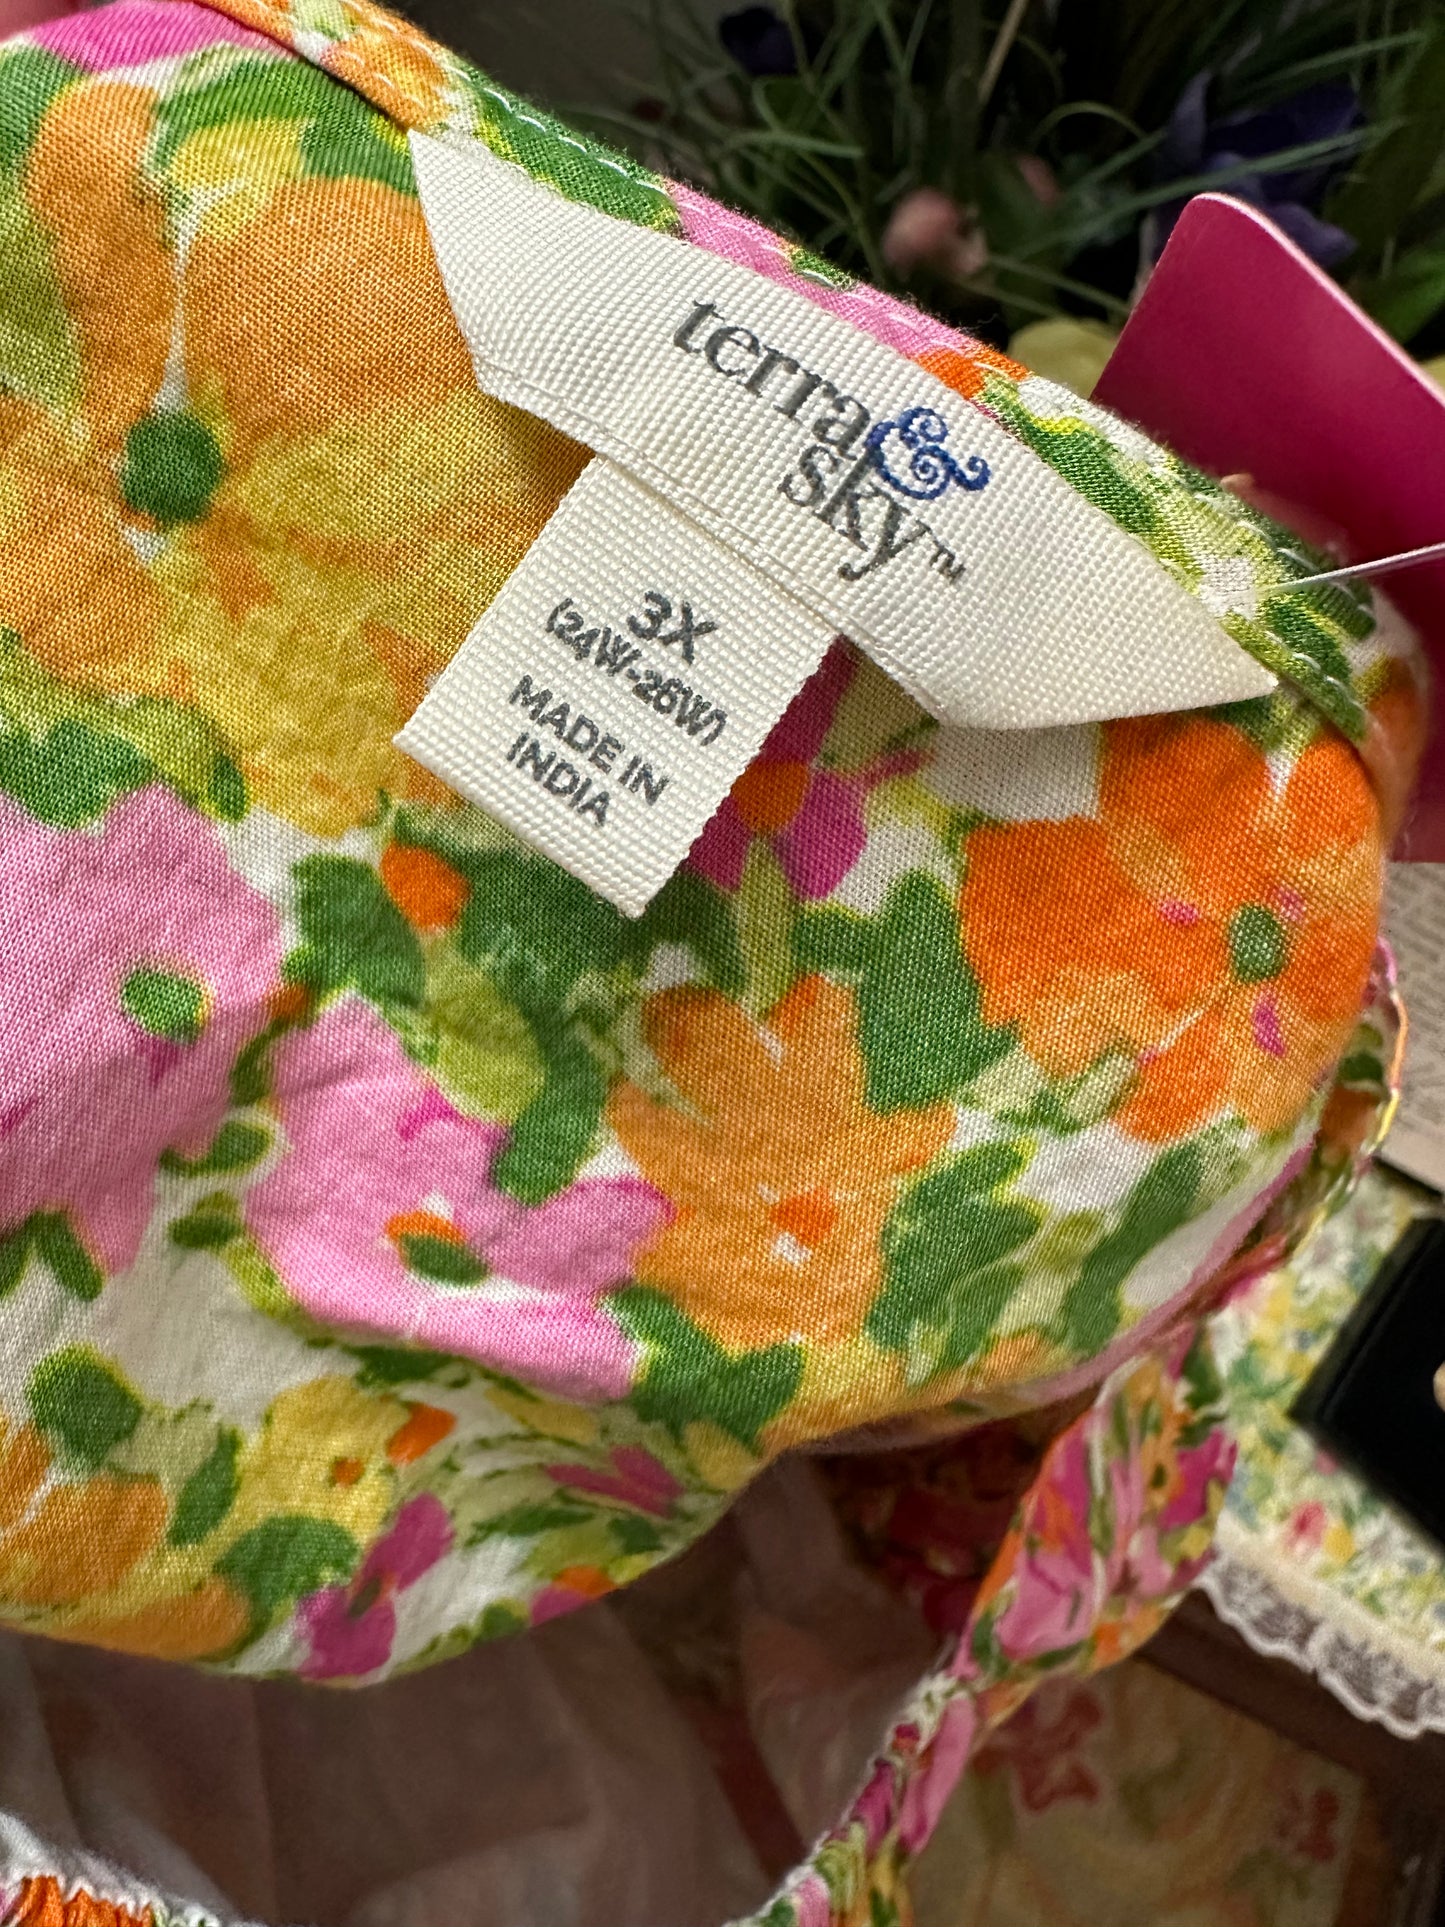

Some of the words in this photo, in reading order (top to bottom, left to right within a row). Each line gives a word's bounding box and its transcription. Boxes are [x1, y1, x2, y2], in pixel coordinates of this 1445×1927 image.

[673, 299, 870, 460] terra
[864, 406, 991, 500] &
[545, 598, 728, 746] (24W-26W)
[626, 590, 718, 665] 3X
[506, 732, 610, 827] INDIA
[508, 684, 625, 775] MADE
[618, 755, 670, 806] IN
